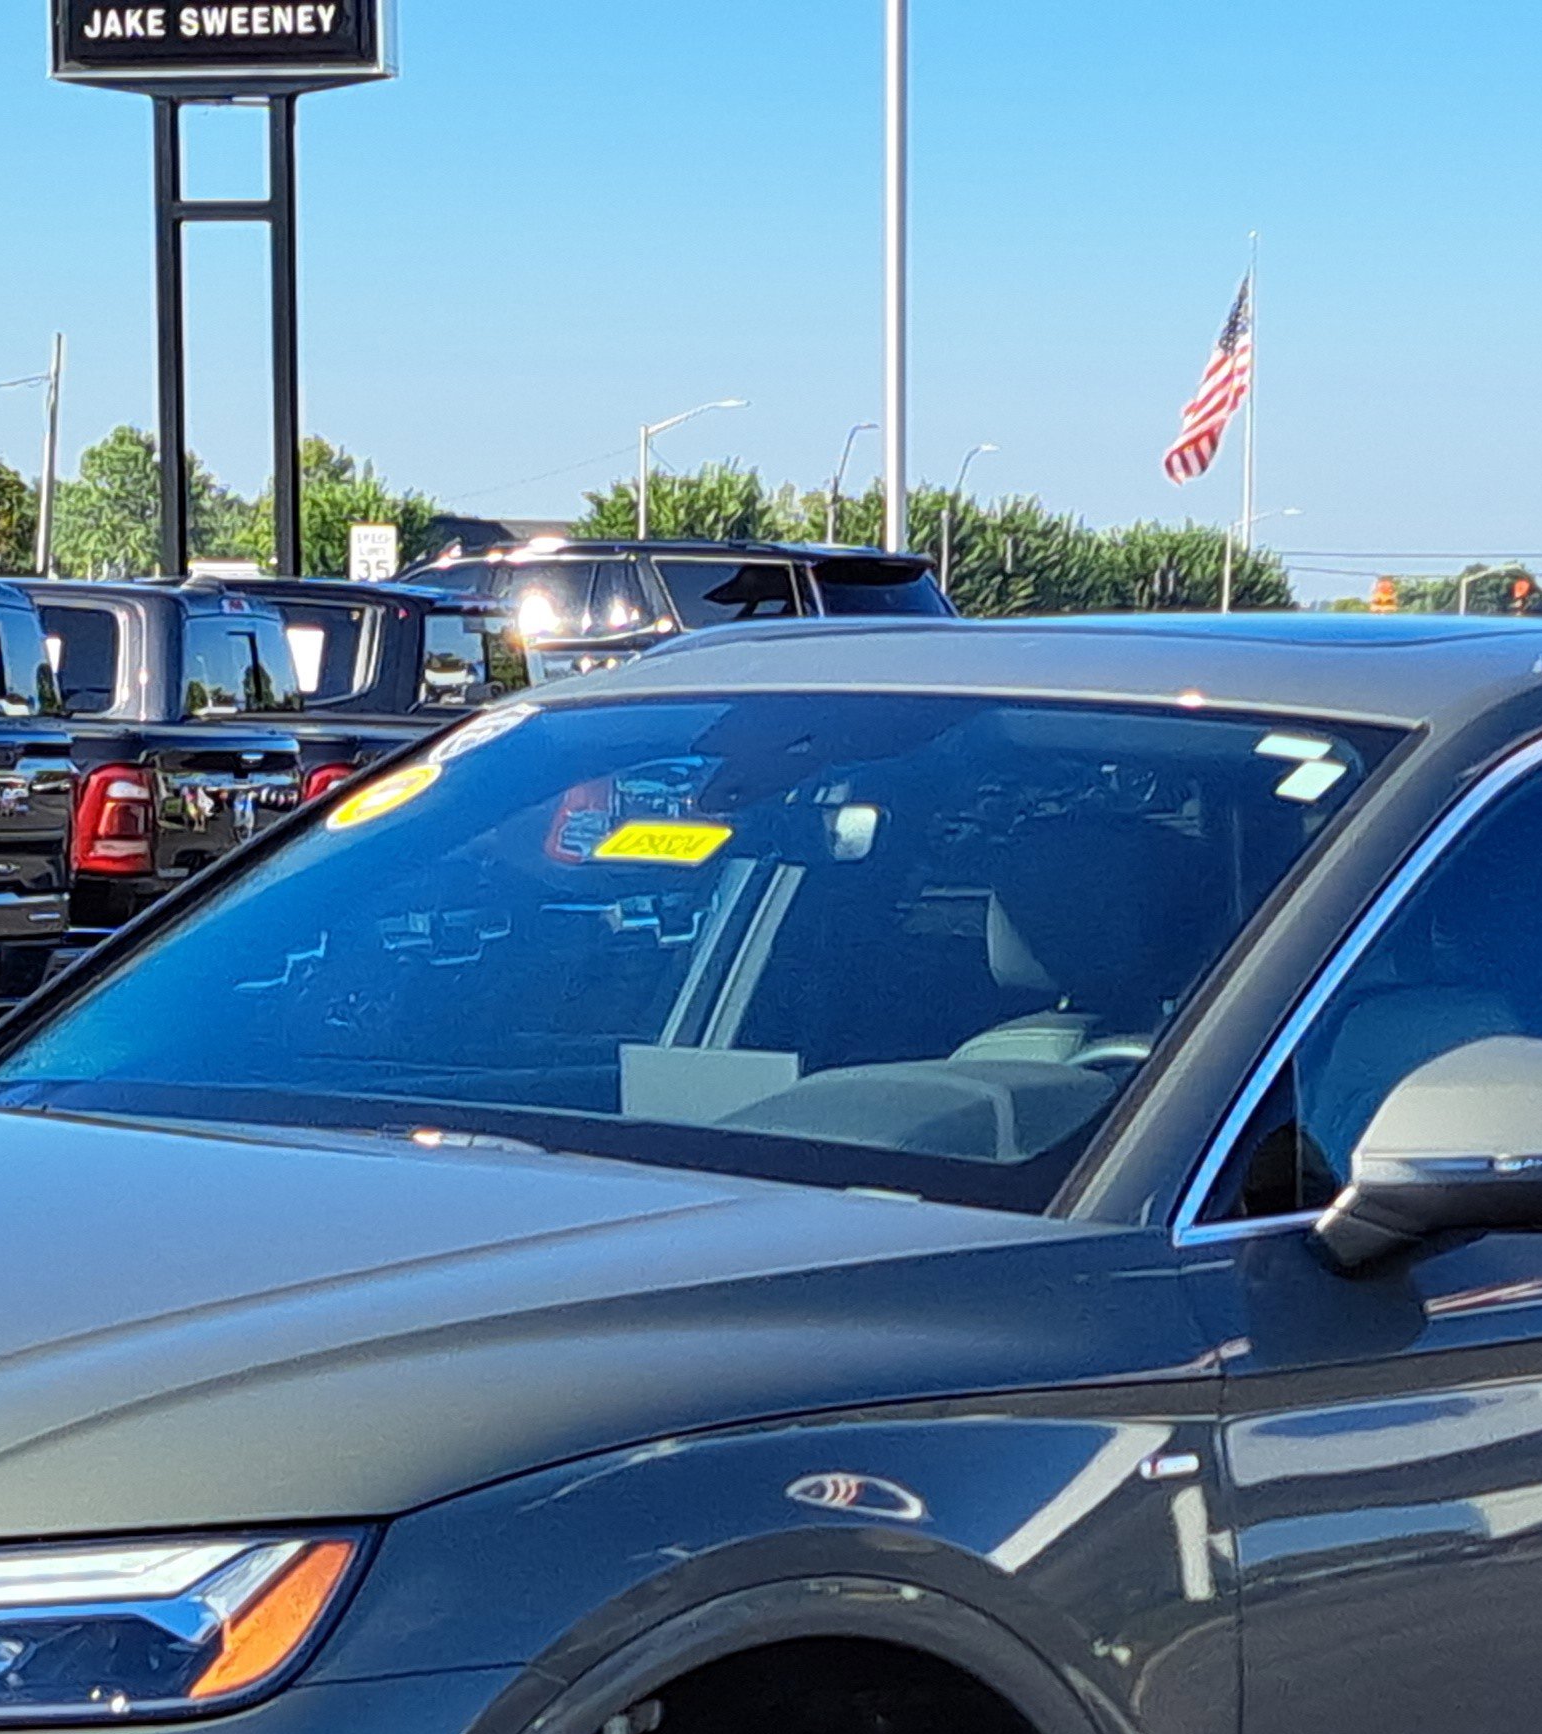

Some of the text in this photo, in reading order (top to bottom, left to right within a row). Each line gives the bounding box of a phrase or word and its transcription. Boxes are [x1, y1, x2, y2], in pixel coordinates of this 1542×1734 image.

[83, 4, 337, 39] JAKE SWEENEY
[357, 559, 391, 582] 35
